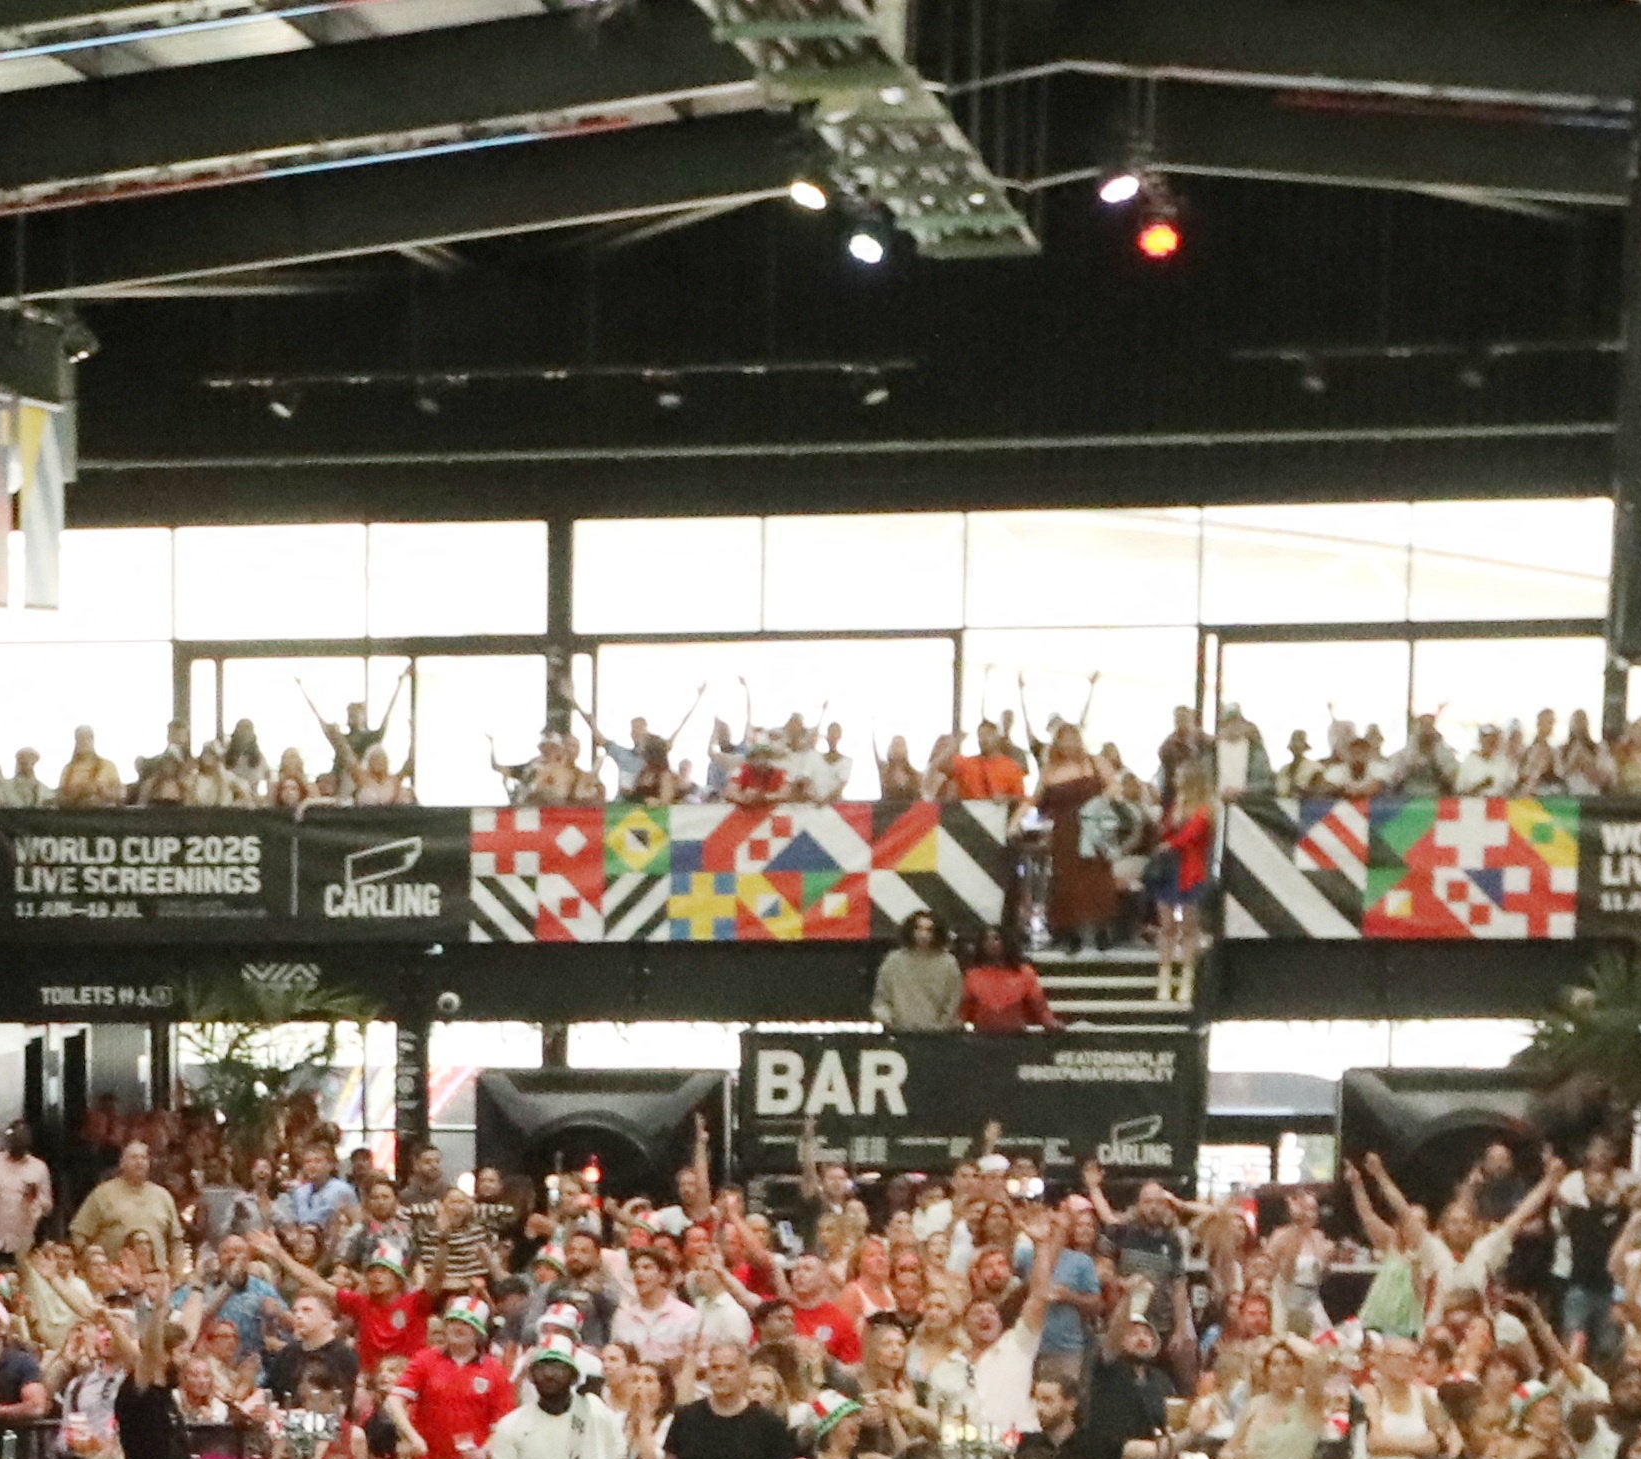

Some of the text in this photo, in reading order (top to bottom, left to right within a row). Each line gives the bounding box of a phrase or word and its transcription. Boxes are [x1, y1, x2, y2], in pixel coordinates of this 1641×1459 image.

[16, 836, 262, 865] WORLD CUP 2026
[15, 865, 262, 895] LIVE SCREENINGS
[323, 884, 441, 917] CARLING
[40, 986, 115, 1006] TOILETS
[755, 1049, 909, 1116] BAR
[1097, 1142, 1174, 1166] CARLING
